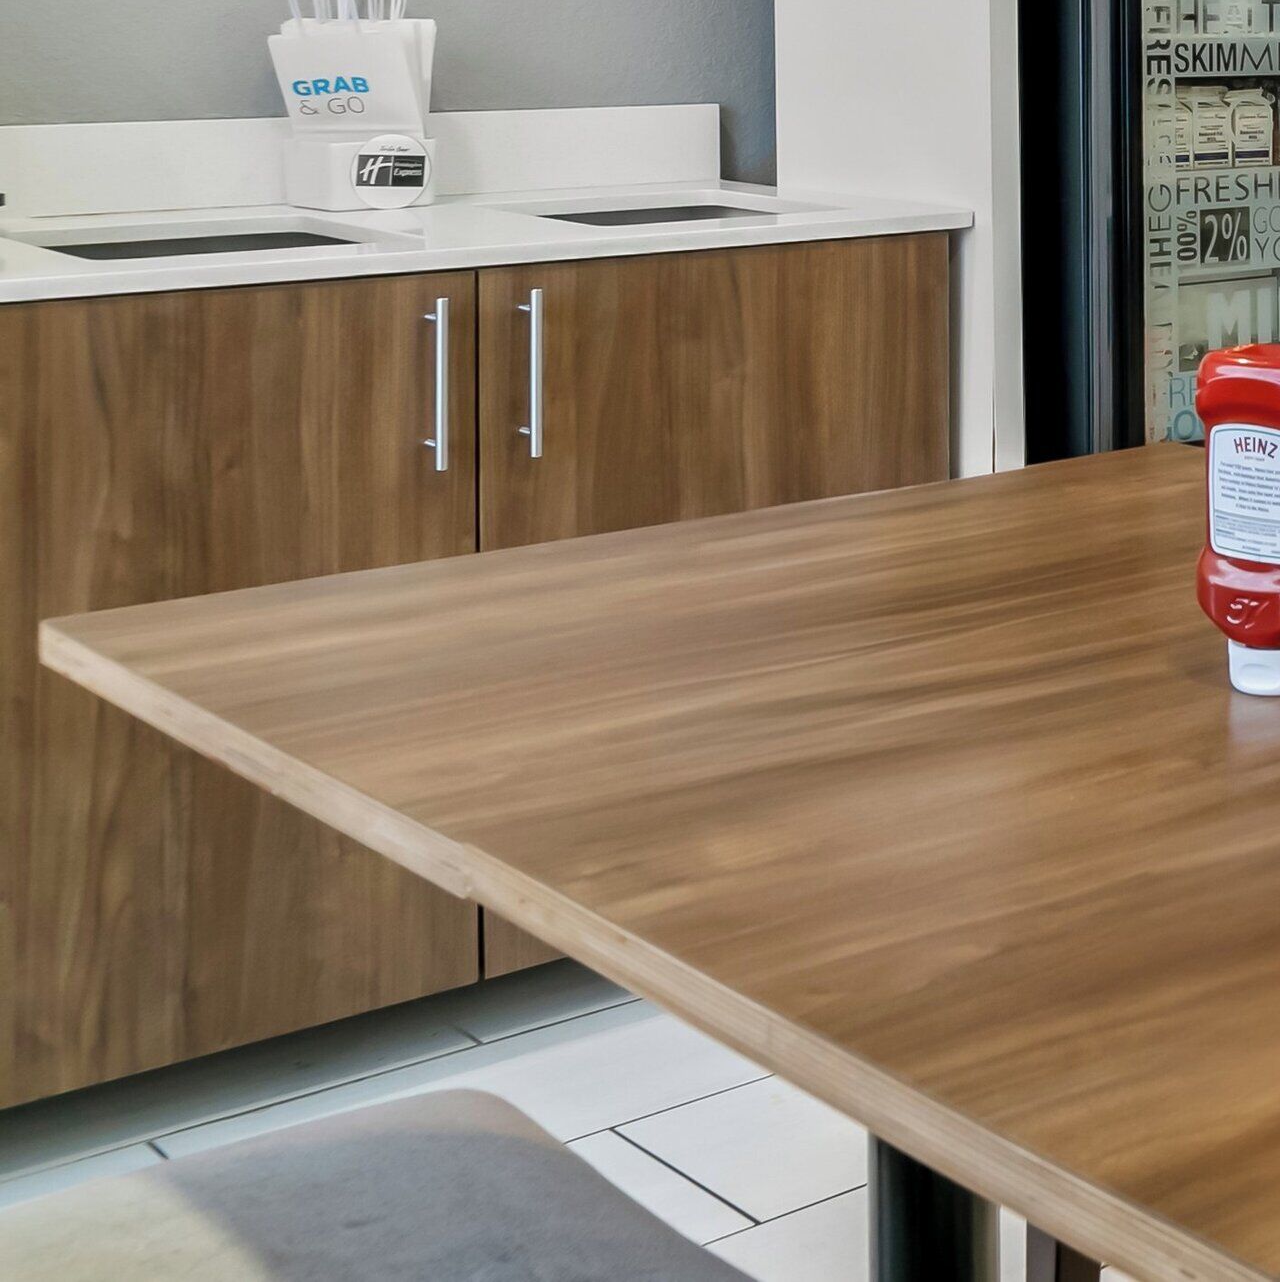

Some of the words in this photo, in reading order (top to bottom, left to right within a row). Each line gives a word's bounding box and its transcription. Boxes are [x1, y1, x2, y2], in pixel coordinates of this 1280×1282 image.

[292, 76, 370, 98] GRAB
[300, 99, 319, 115] &
[327, 95, 365, 114] GO
[1204, 211, 1248, 264] 2%
[1233, 436, 1279, 459] HEINZ
